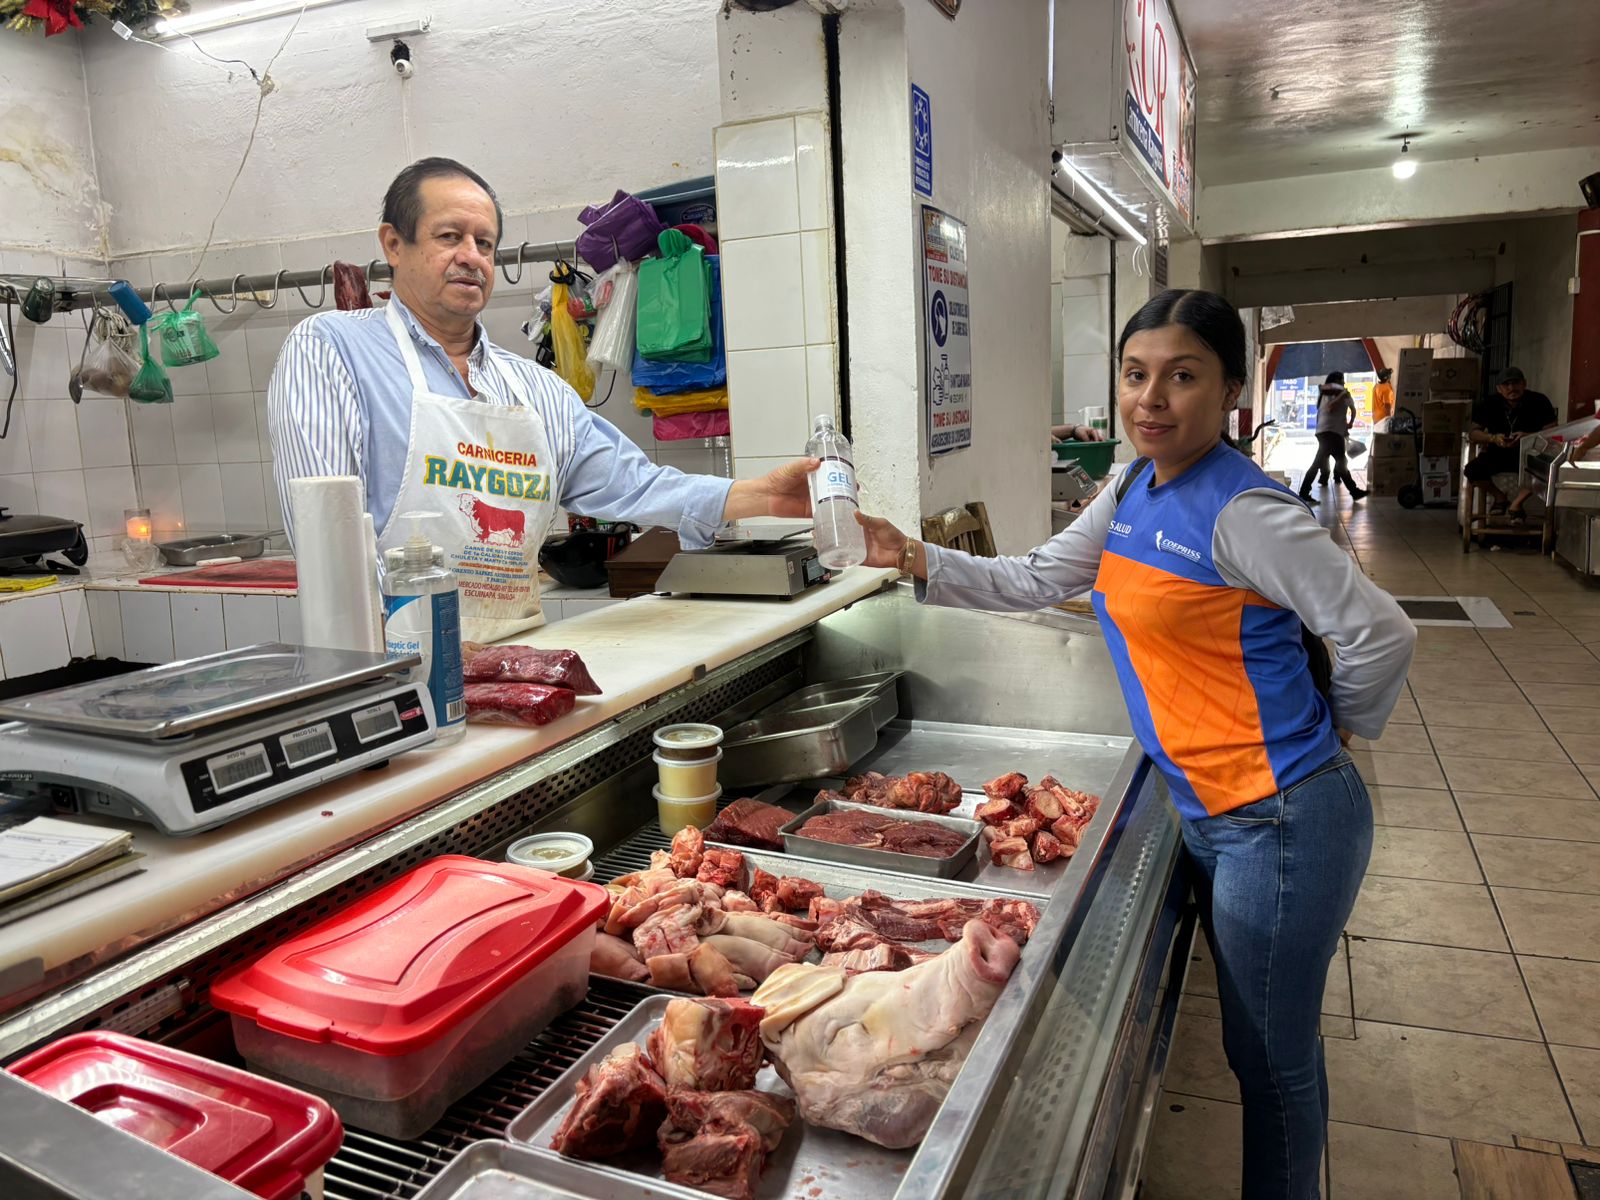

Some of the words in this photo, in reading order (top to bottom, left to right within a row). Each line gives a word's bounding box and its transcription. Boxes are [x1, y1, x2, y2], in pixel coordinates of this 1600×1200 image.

[457, 441, 537, 467] CARNICERIA
[828, 471, 852, 486] GEL
[1109, 519, 1132, 535] SALUD
[1162, 538, 1201, 560] COEPRISS
[450, 553, 478, 561] CHULETA
[458, 580, 481, 590] MERCADO
[406, 640, 420, 650] Gel
